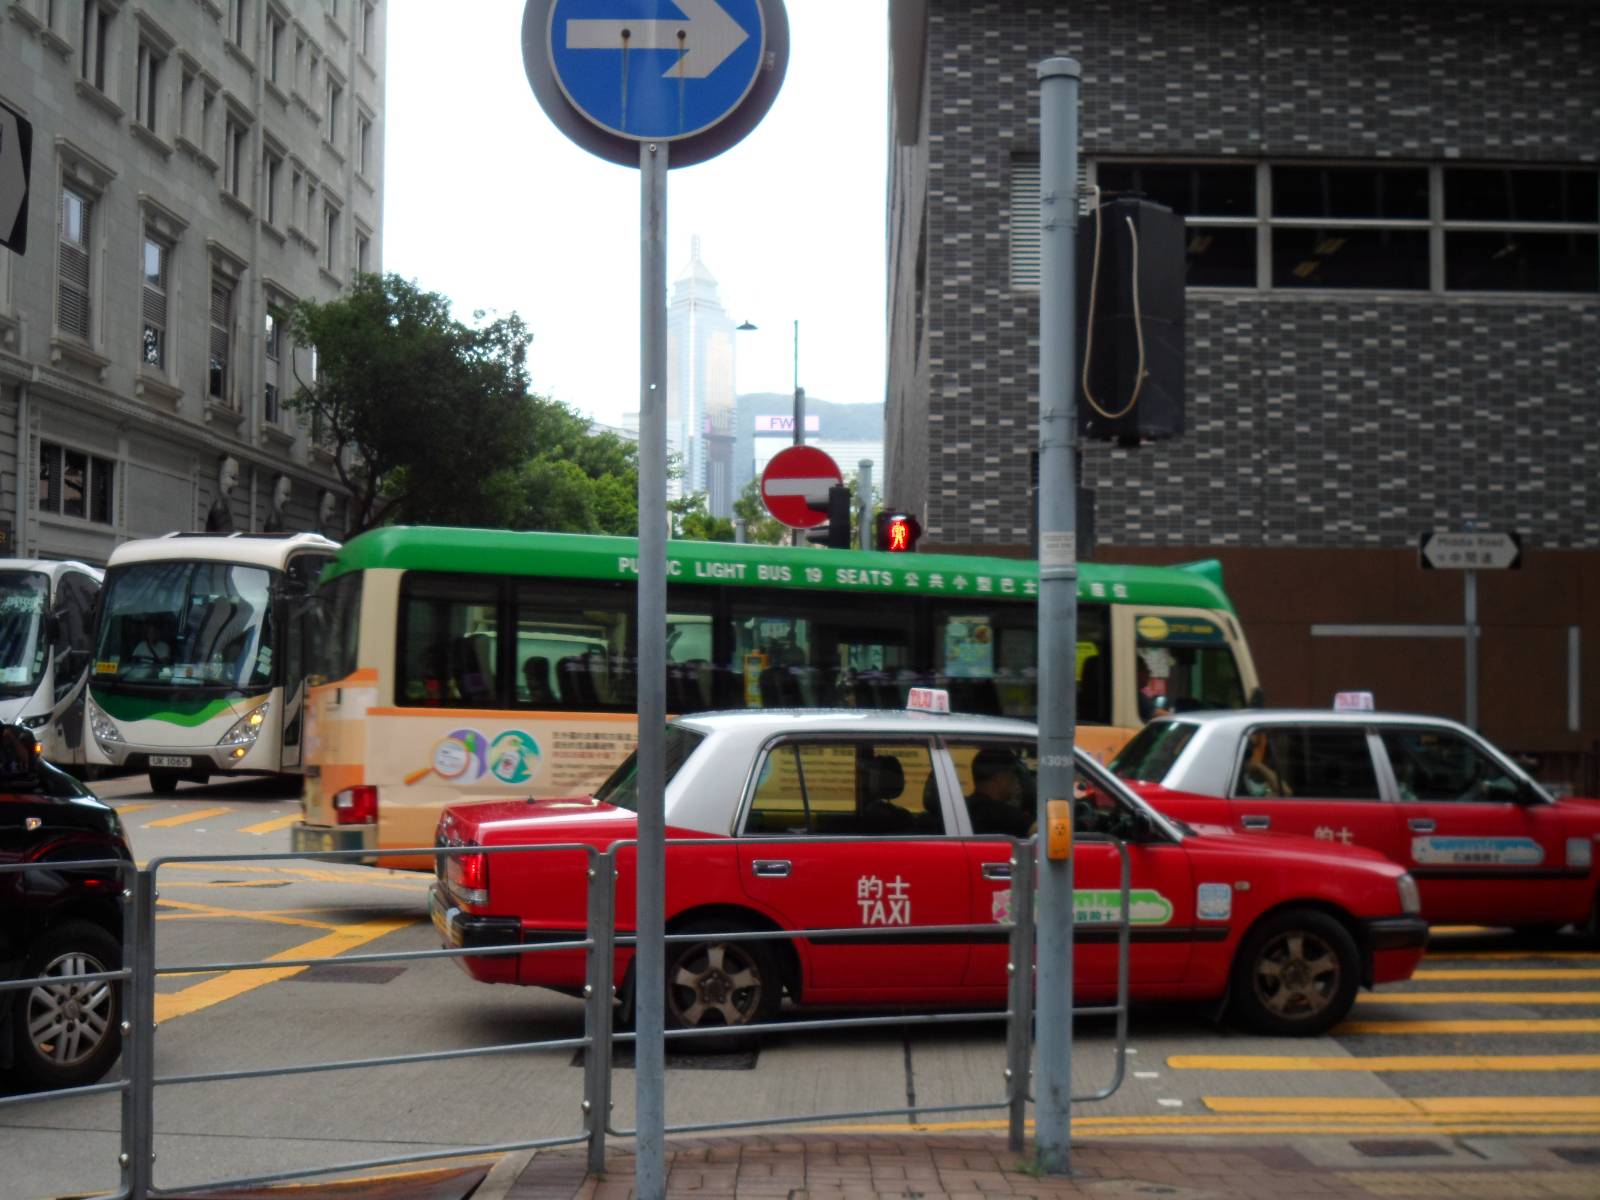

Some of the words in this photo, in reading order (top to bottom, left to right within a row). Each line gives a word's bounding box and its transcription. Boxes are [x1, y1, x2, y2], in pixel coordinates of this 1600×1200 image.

[770, 417, 796, 429] FW
[618, 557, 682, 576] PUIC
[695, 561, 747, 580] LIGHT
[757, 564, 792, 582] BUS
[805, 567, 823, 583] 19
[836, 568, 893, 586] SEATS
[857, 874, 911, 899] 的士
[857, 899, 911, 925] TAXI
